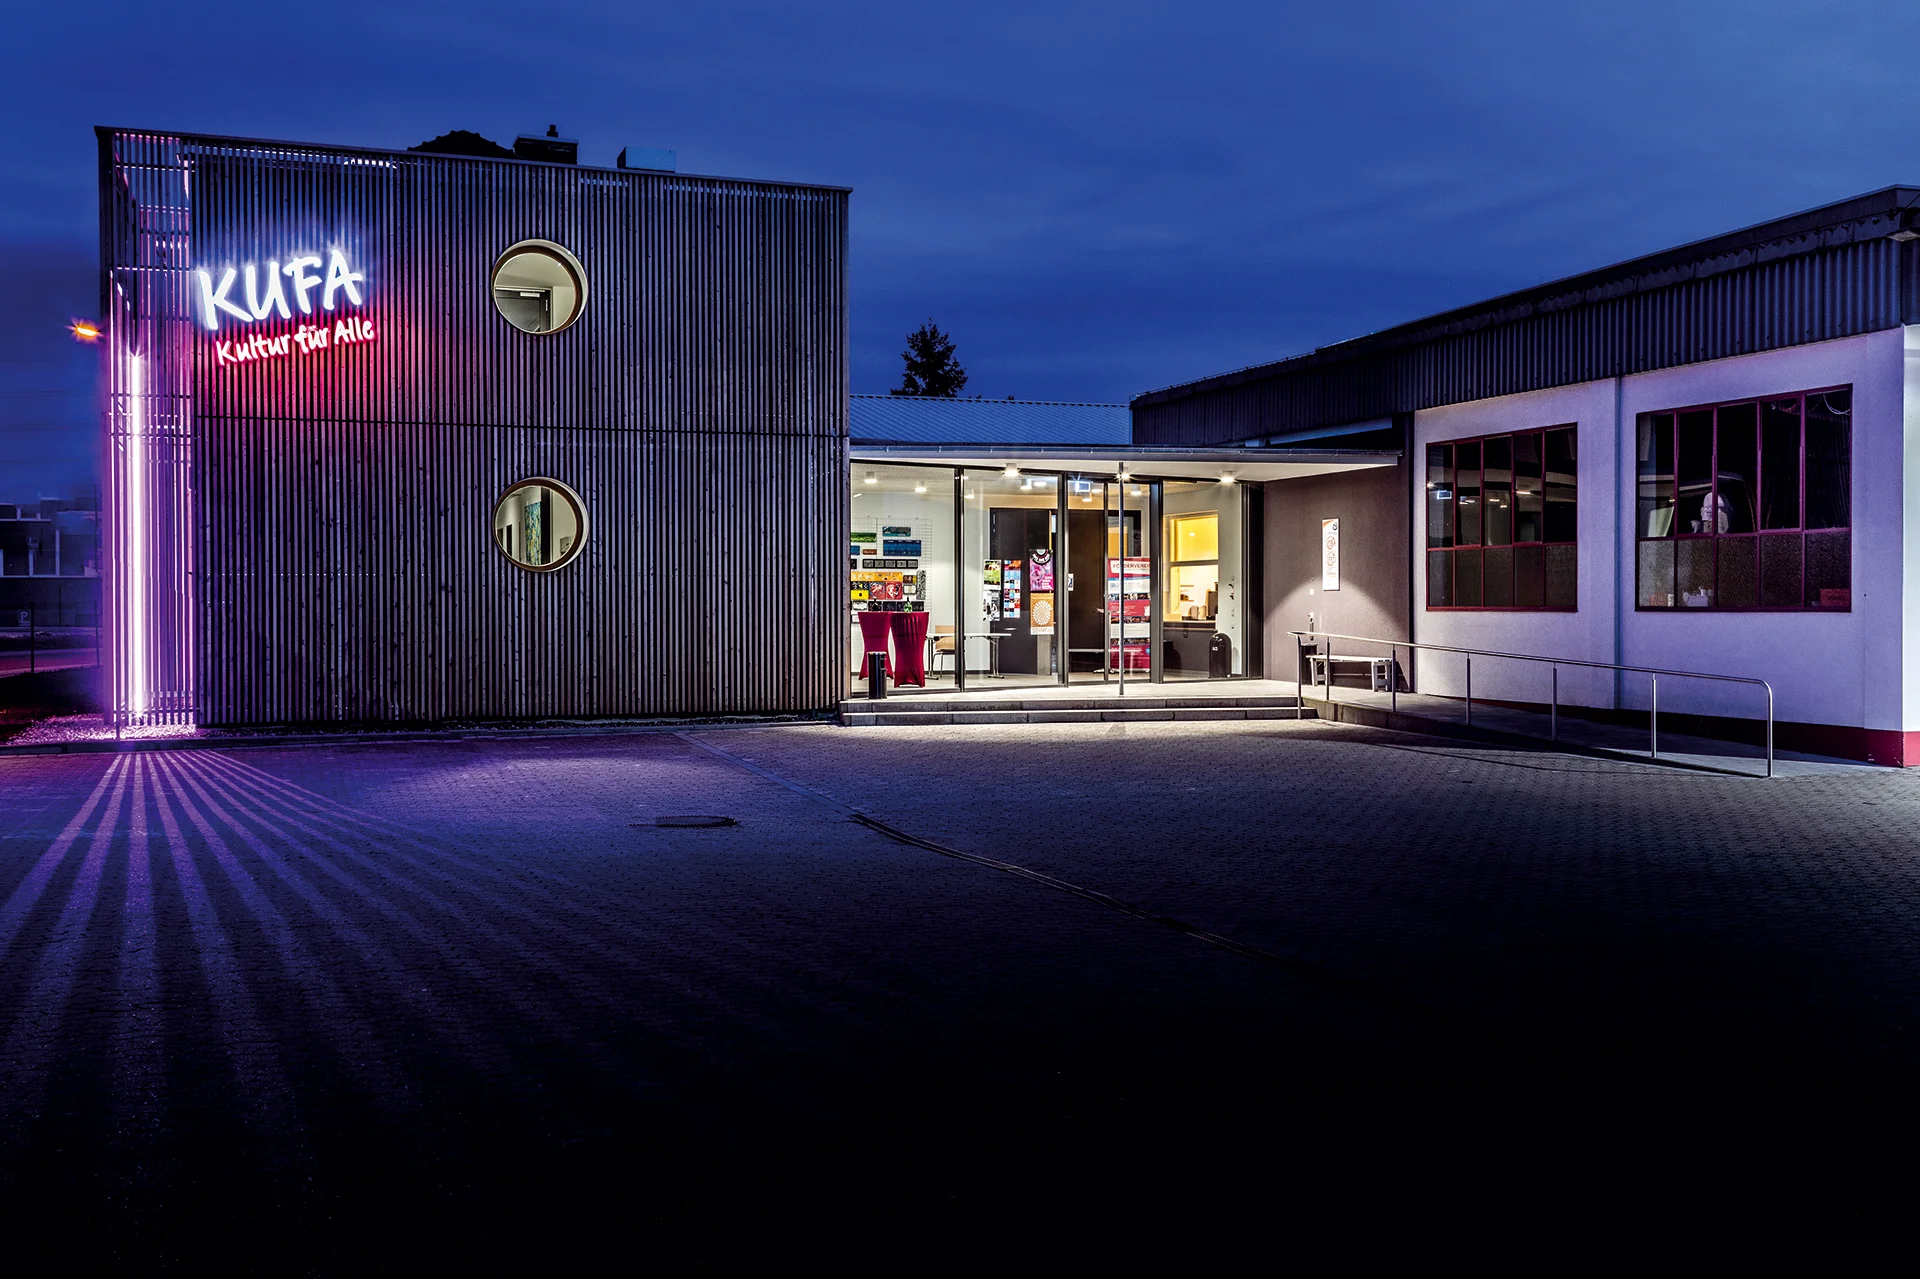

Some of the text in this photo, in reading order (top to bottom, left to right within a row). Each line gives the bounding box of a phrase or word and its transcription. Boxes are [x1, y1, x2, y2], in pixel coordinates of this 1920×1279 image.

[199, 249, 363, 330] KUFA
[216, 316, 375, 365] Kultur für Alle
[20, 611, 29, 621] P
